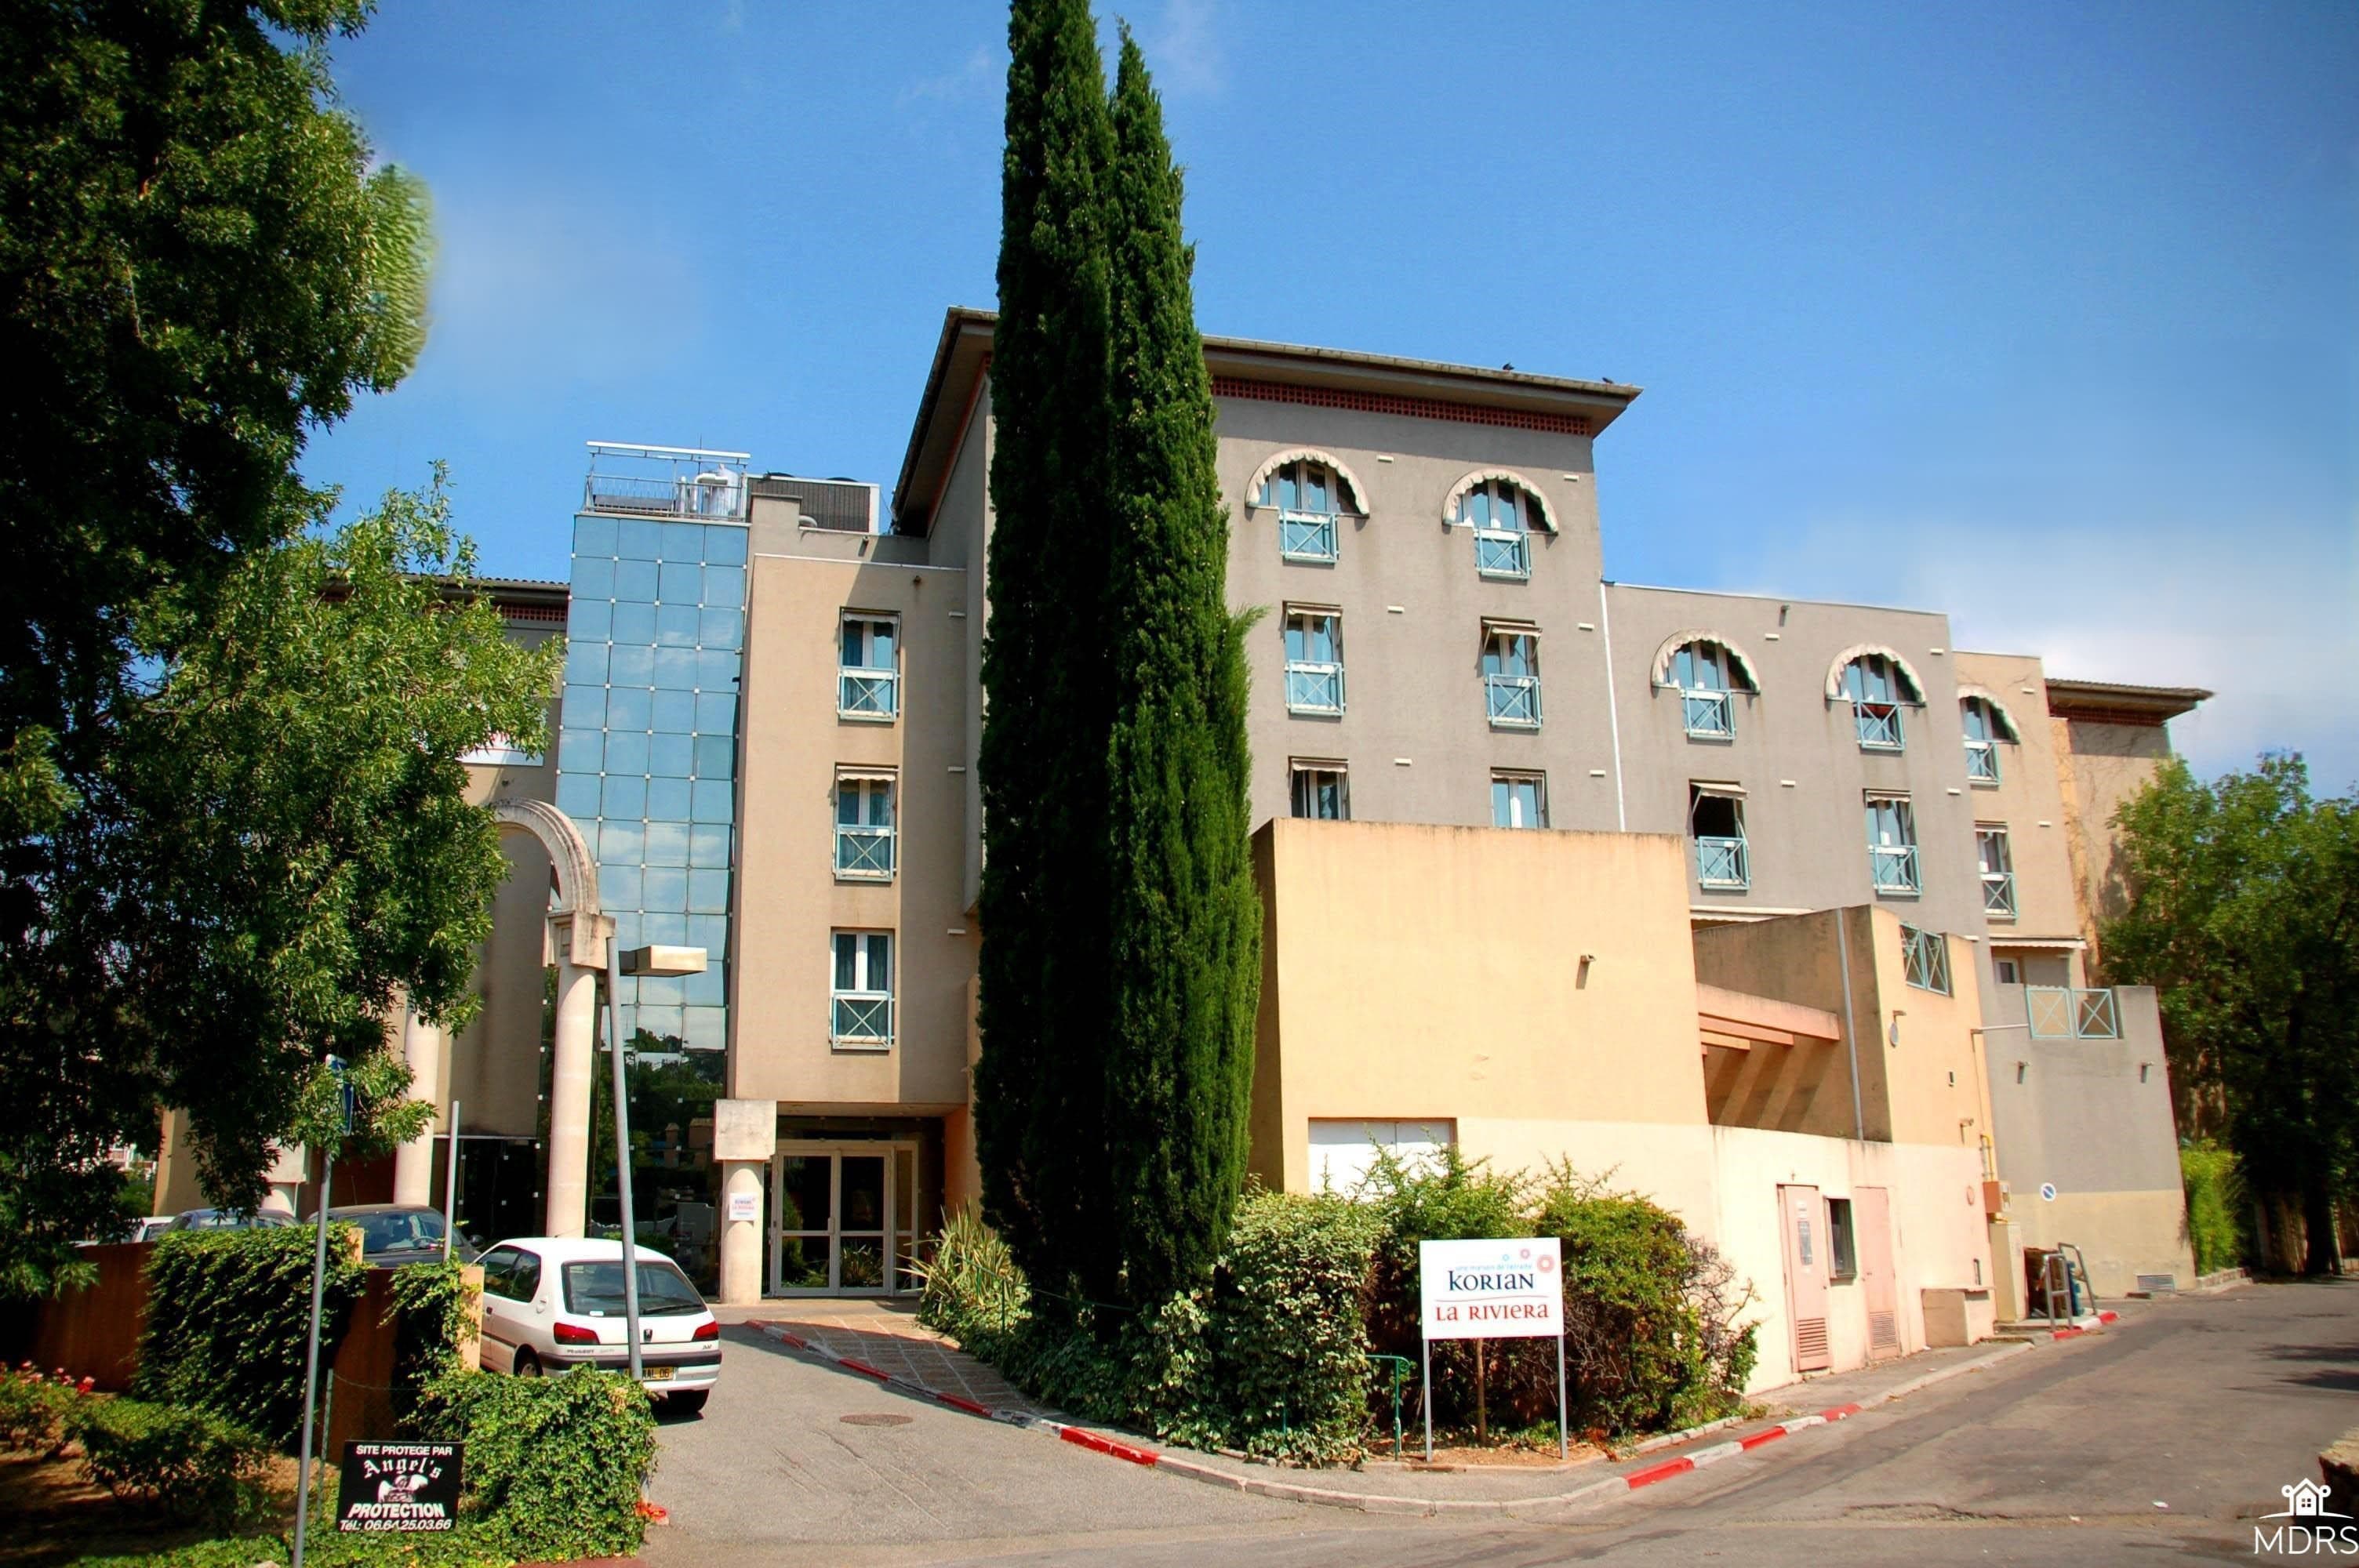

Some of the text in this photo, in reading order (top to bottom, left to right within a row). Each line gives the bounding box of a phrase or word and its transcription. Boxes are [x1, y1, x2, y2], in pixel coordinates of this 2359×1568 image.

[356, 1445, 453, 1456] SITE PROTEGE PAR
[363, 1457, 443, 1479] Angel's
[347, 1503, 445, 1519] PROTECTION
